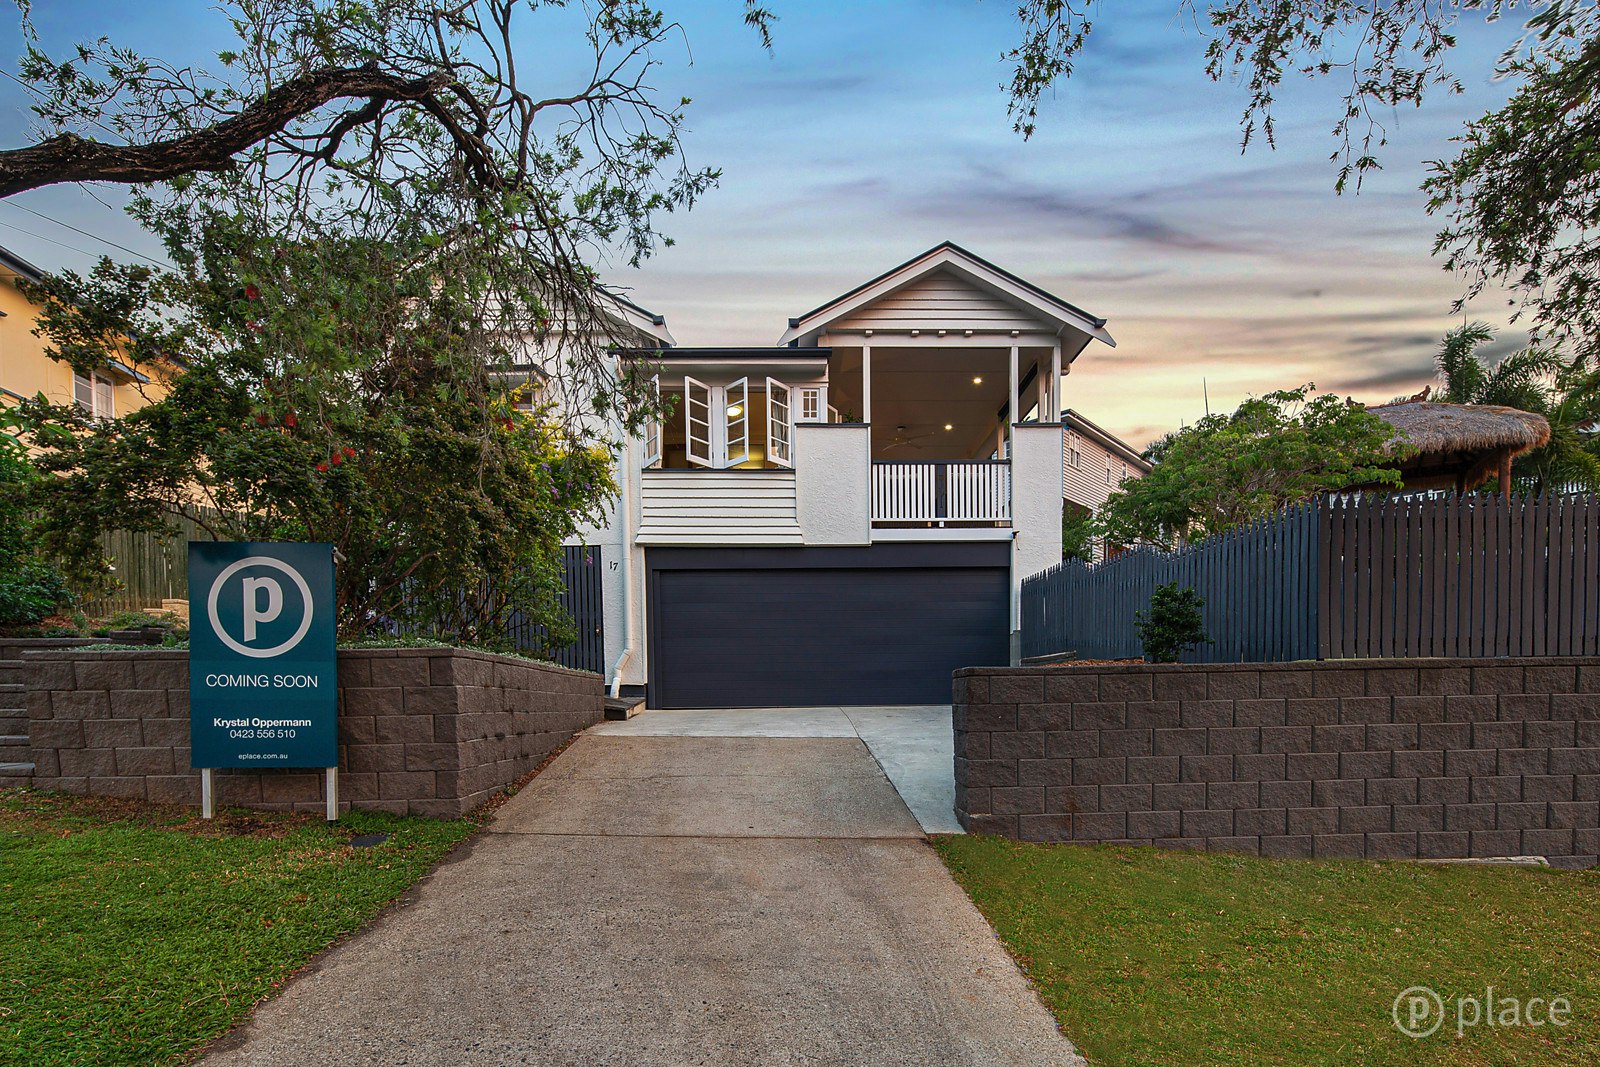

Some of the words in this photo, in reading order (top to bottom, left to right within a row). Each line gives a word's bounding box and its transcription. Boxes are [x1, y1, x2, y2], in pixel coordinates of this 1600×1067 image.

[609, 560, 619, 571] 17
[242, 576, 283, 643] p
[205, 673, 269, 688] COMING
[273, 674, 318, 688] SOON
[213, 717, 250, 729] Krystal
[251, 717, 312, 729] Oppermann
[229, 729, 255, 739] 0423
[256, 729, 276, 739] 556
[277, 729, 296, 739] 510
[238, 753, 289, 761] eplace.com.au
